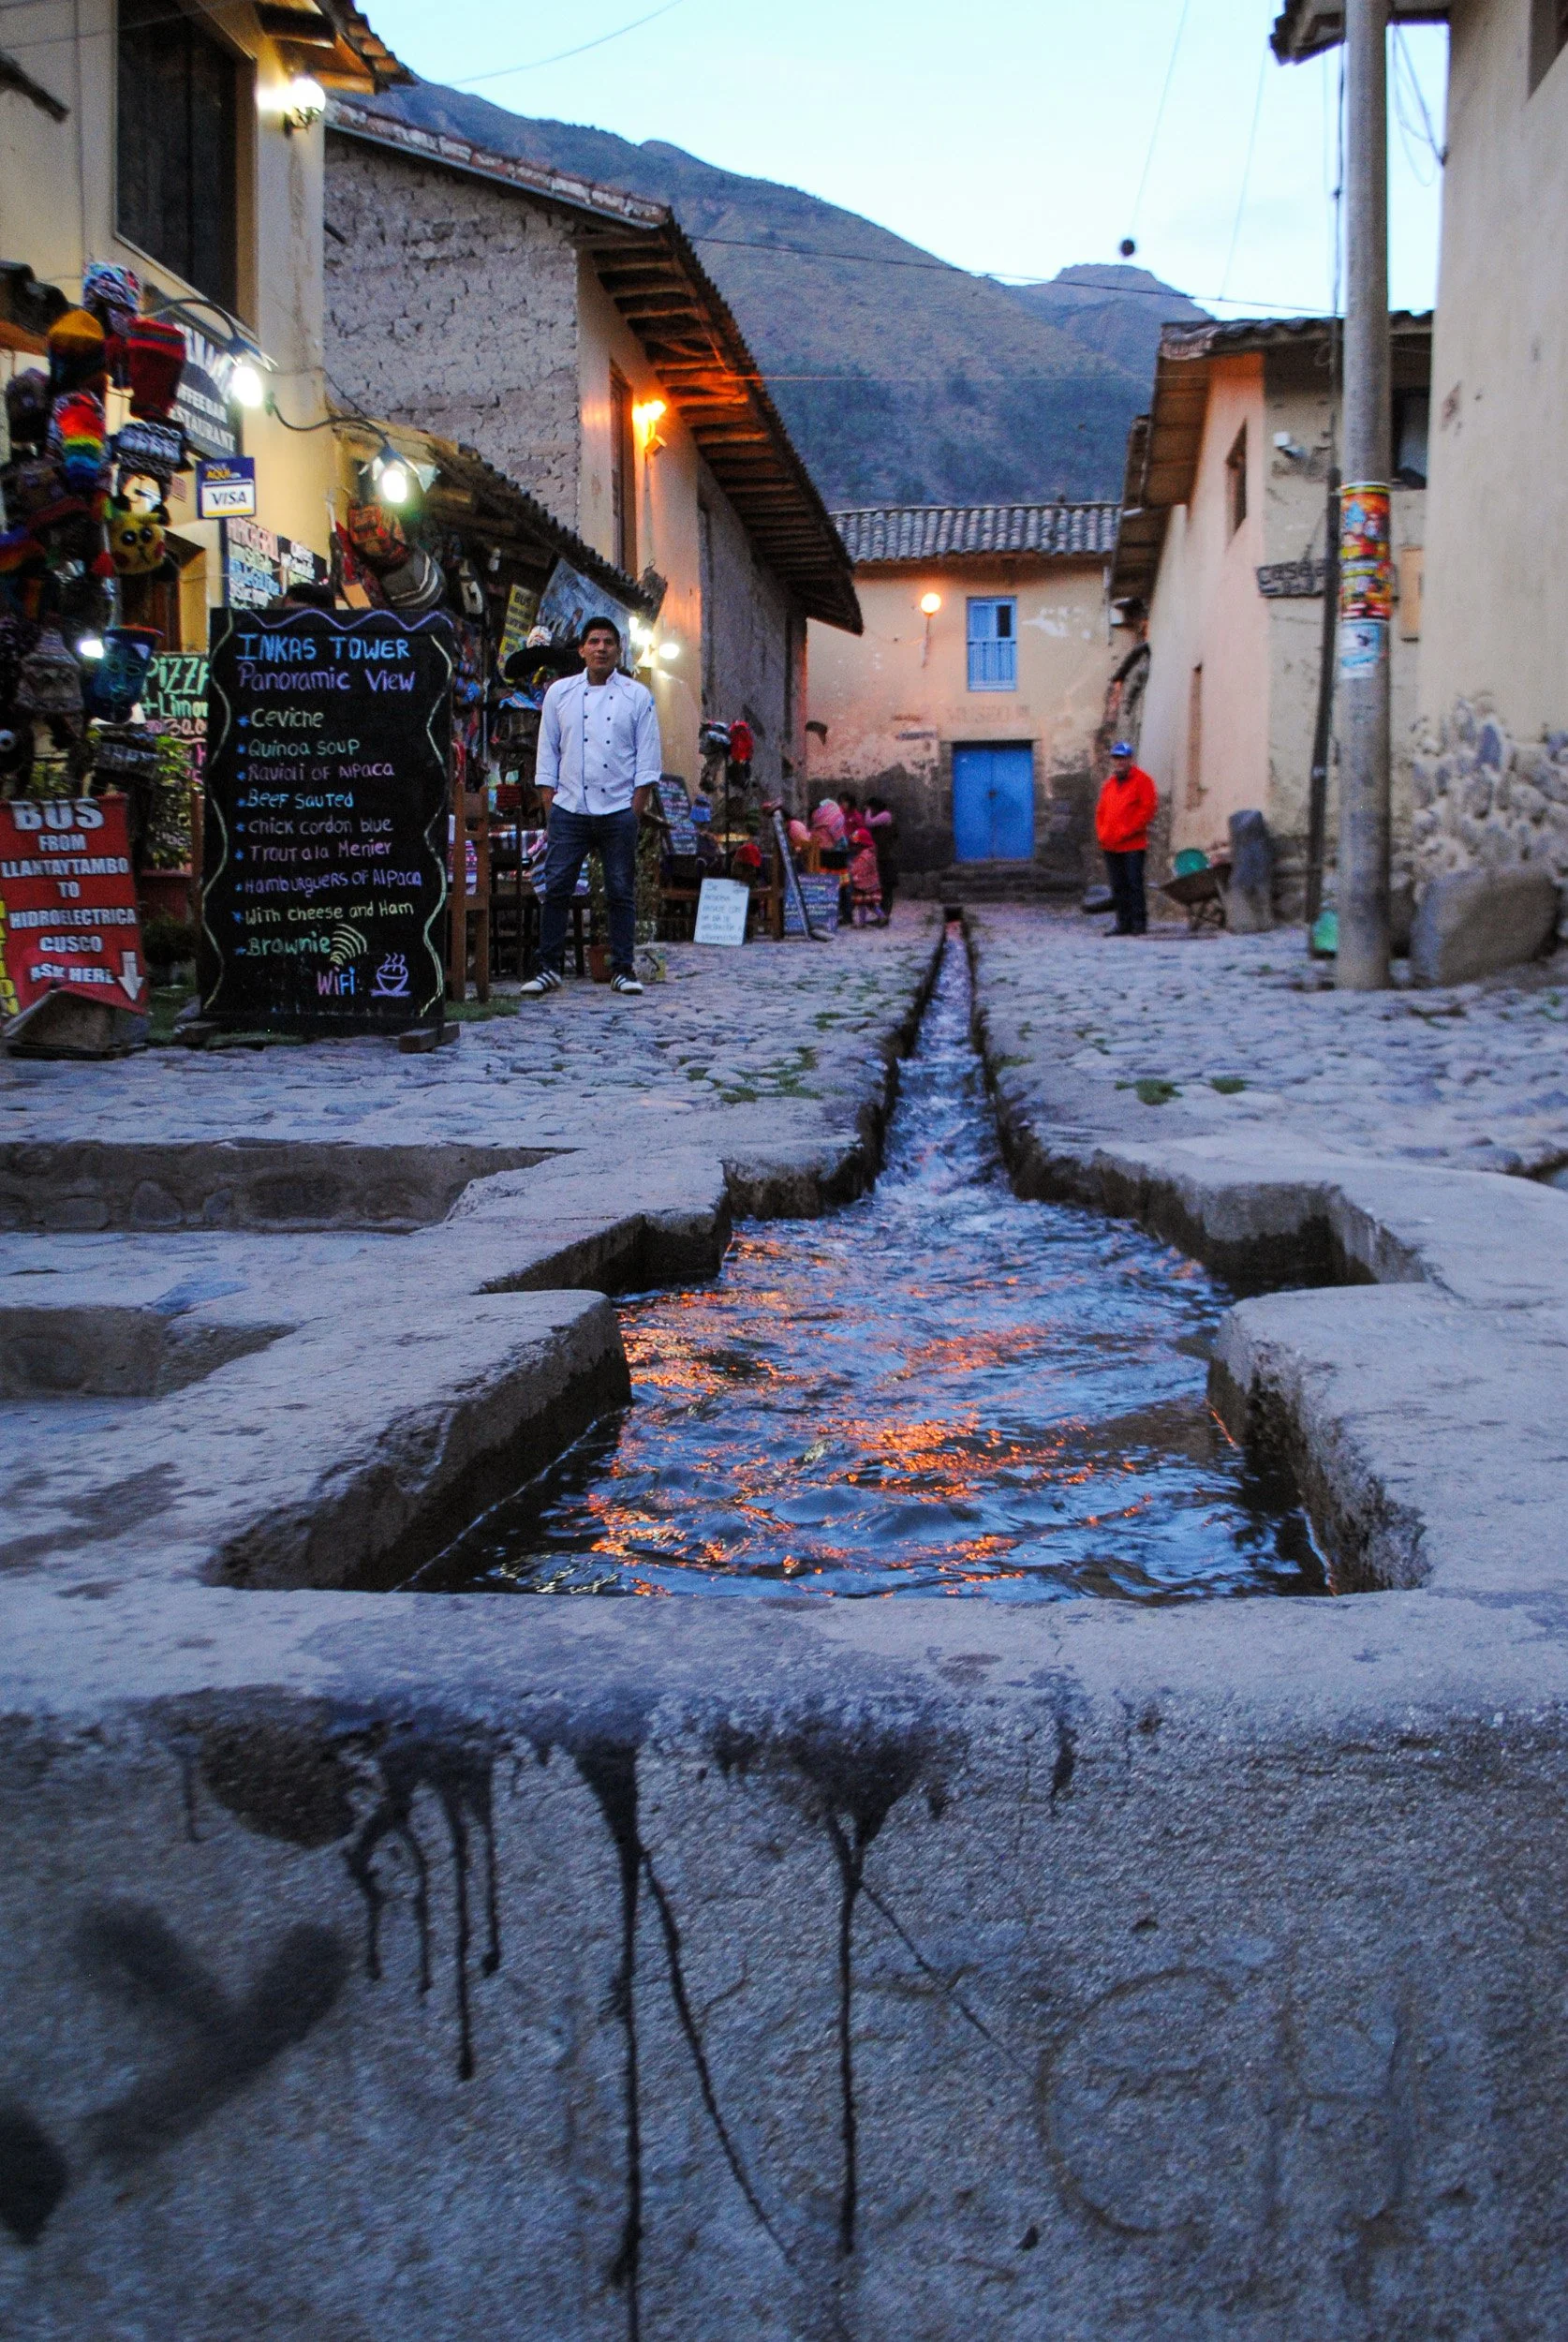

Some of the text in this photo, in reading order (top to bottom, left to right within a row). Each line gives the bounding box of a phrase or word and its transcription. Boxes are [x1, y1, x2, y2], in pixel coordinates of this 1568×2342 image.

[211, 491, 246, 506] VISA
[236, 633, 410, 662] INKAS TOWER
[238, 662, 416, 692] Panoramic View
[251, 707, 324, 728] Ceviche
[247, 739, 310, 757] Quinoa
[9, 797, 104, 831] BUS
[361, 817, 393, 834] blue
[38, 835, 86, 852] FROM
[57, 881, 81, 898] TO
[379, 900, 414, 916] Ham
[9, 907, 137, 929] HIDROELECTRICA
[39, 935, 103, 953] CUSCO
[246, 931, 331, 956] Brownie
